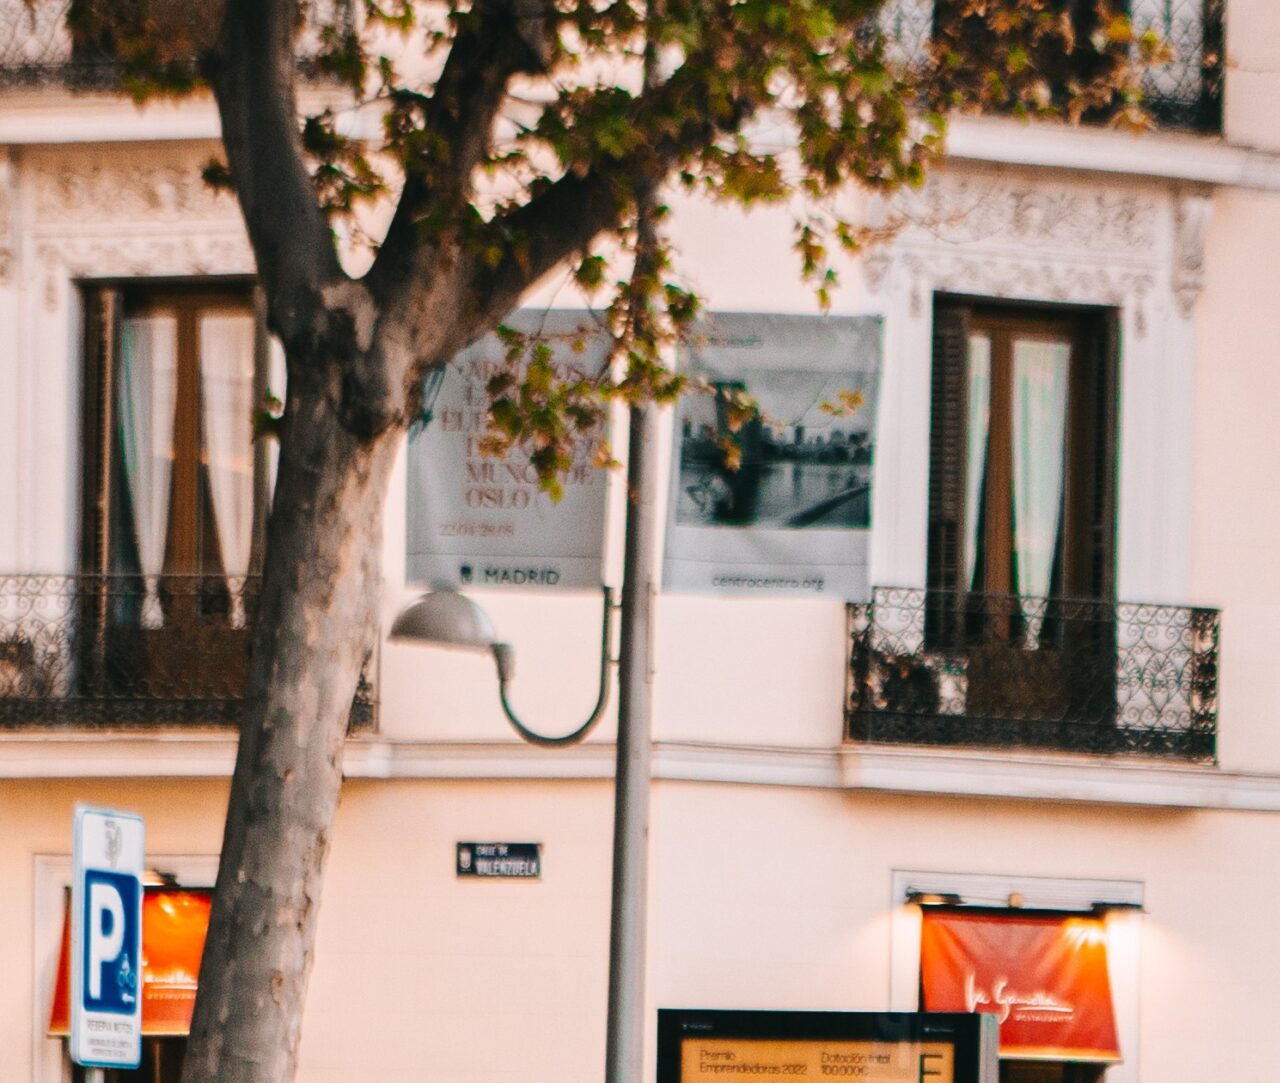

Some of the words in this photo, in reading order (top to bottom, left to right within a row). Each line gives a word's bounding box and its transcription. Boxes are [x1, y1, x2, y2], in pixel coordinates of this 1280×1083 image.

[466, 463, 540, 484] MUNC
[466, 489, 530, 509] OSLO
[485, 570, 560, 585] MADRID
[712, 576, 824, 592] centrocentro.org
[90, 882, 125, 1000] P
